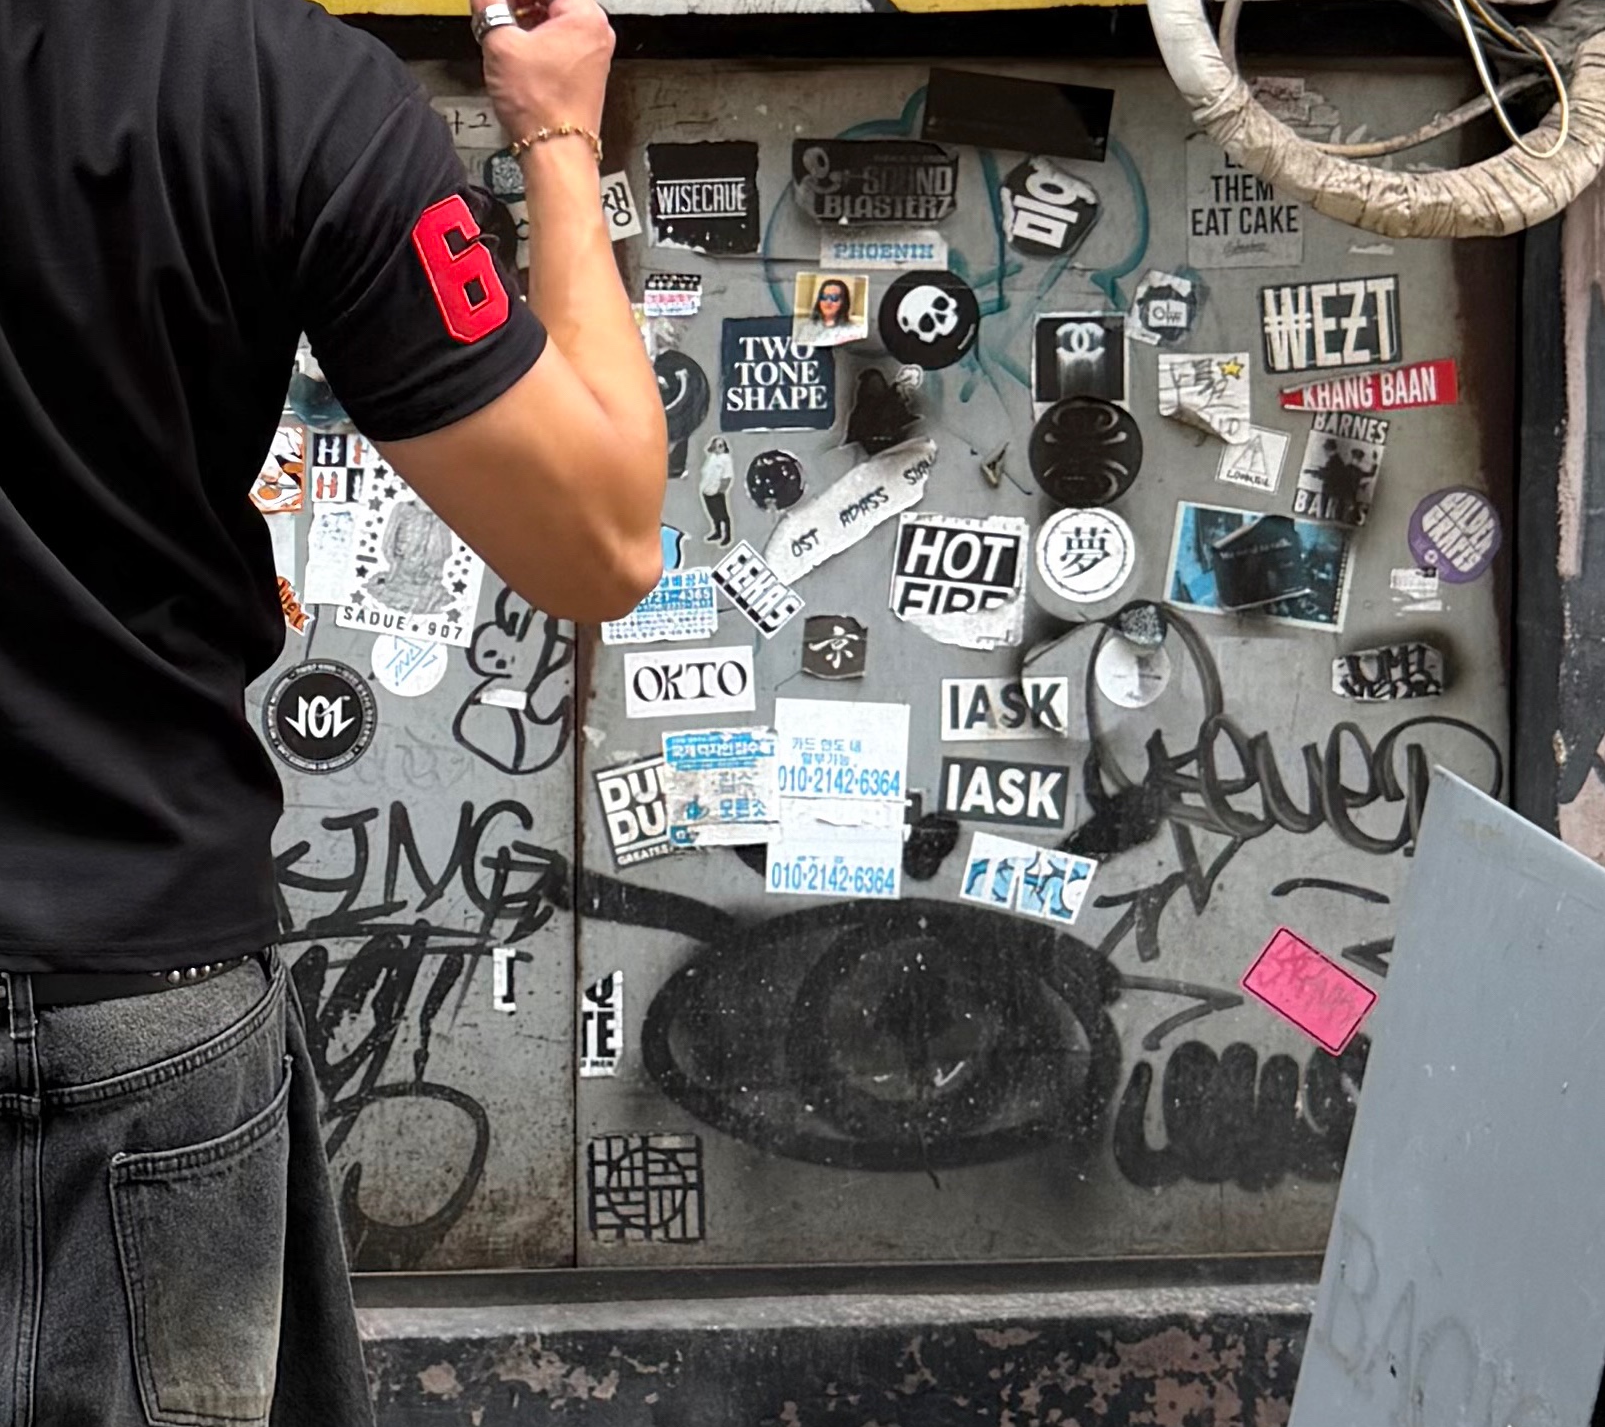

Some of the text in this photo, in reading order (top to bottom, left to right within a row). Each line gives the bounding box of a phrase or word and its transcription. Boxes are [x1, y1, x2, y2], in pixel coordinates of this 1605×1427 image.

[1211, 174, 1274, 202] THEM
[1191, 204, 1299, 236] EAT CAKE
[413, 193, 509, 344] 6
[834, 242, 934, 260] PHOENIX
[739, 336, 814, 361] TWO
[734, 362, 820, 386] TONE
[1302, 366, 1438, 409] KHANG BAAN
[726, 386, 828, 412] SHAPE
[1313, 413, 1387, 445] BARNES
[904, 527, 1015, 582] HOT
[1059, 526, 1113, 579] 夢
[343, 606, 463, 641] SADUE 907
[632, 660, 748, 702] OKTO
[950, 682, 1063, 730] IASK
[946, 764, 1062, 820] IASK
